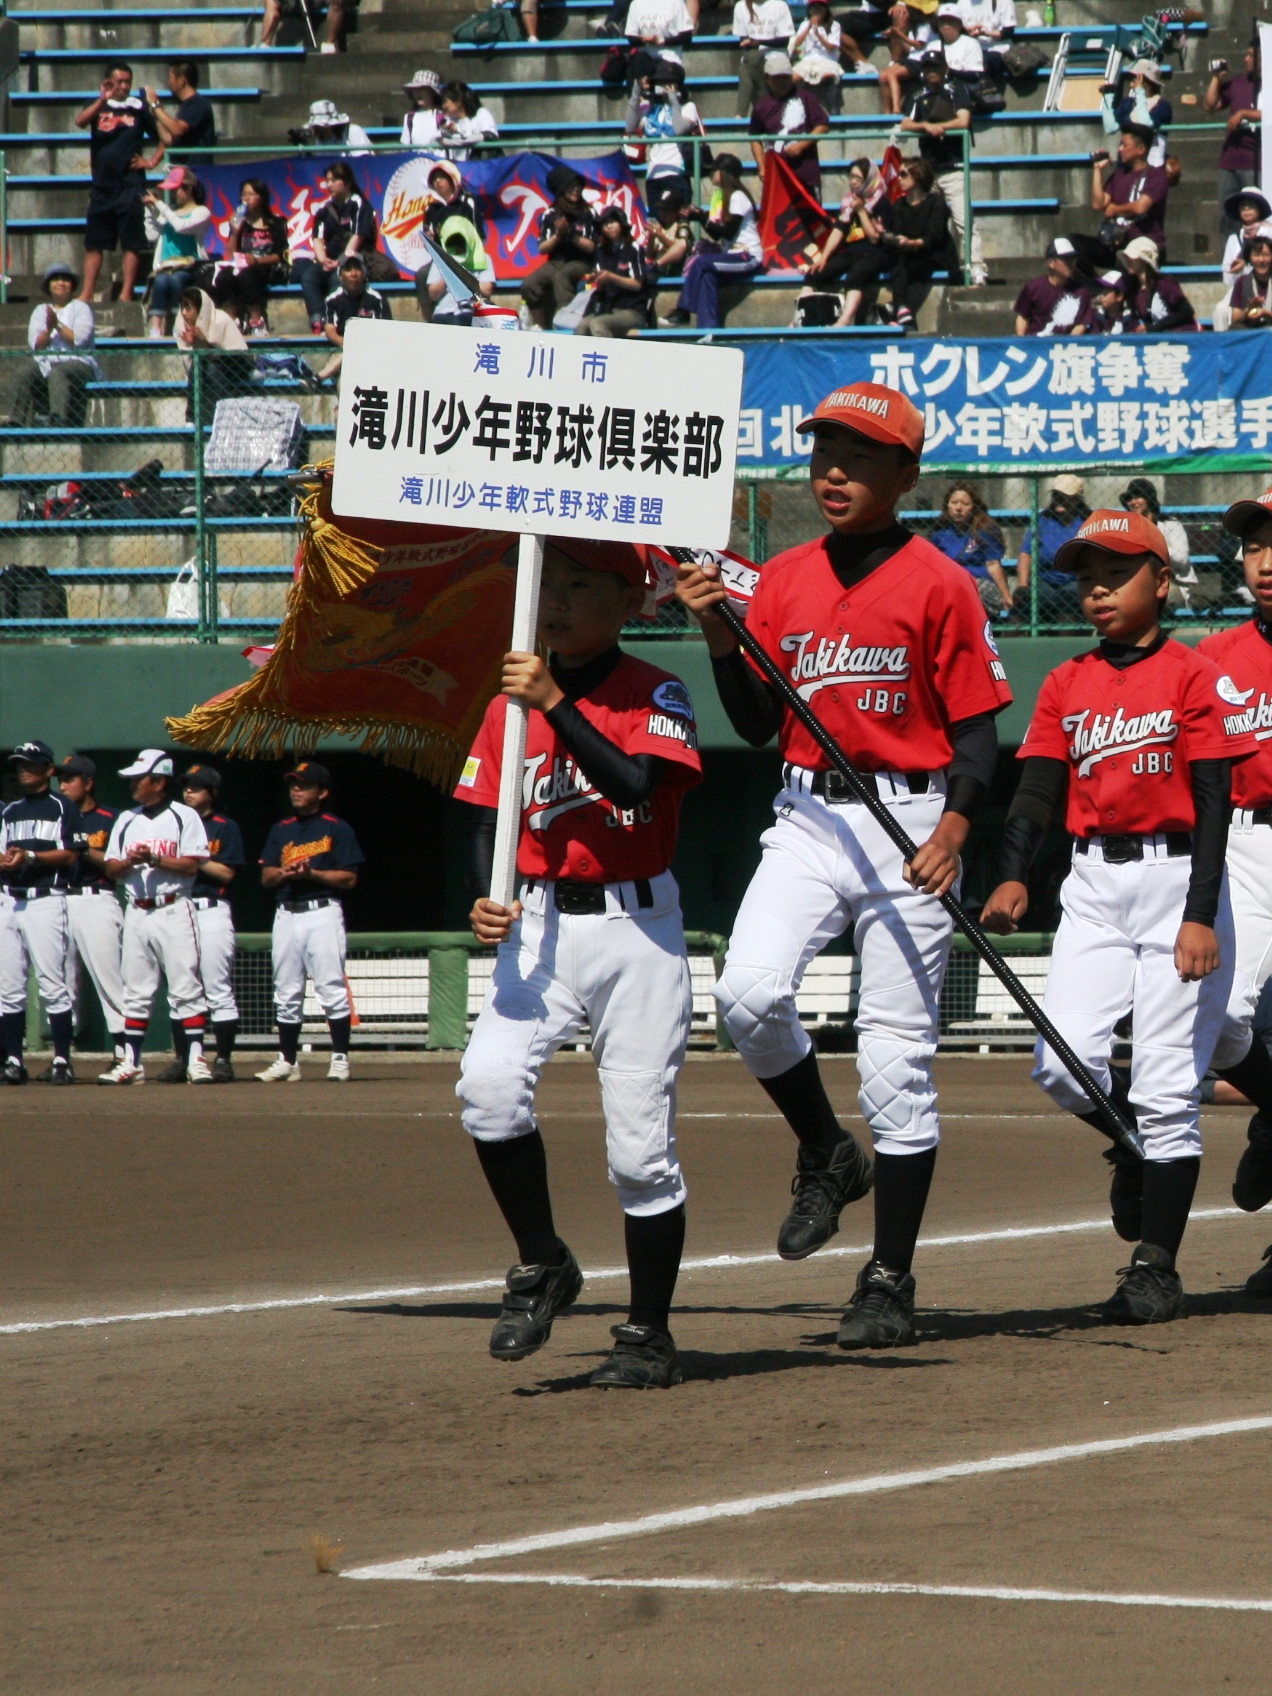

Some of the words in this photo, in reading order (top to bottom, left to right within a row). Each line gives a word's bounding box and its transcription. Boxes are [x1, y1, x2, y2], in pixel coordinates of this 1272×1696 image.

[472, 343, 609, 384] 滝川市
[870, 342, 1191, 396] ホクレン旗争奪
[824, 392, 890, 420] TAKIKAWA
[348, 385, 725, 479] 滝川少年野球倶楽部
[398, 475, 664, 526] 滝川少年軟式野球連盟
[779, 630, 911, 684] Takikawa
[856, 687, 908, 716] JBC
[1061, 704, 1179, 761] Takikawa
[1131, 751, 1174, 775] JBC
[604, 800, 654, 828] JBC
